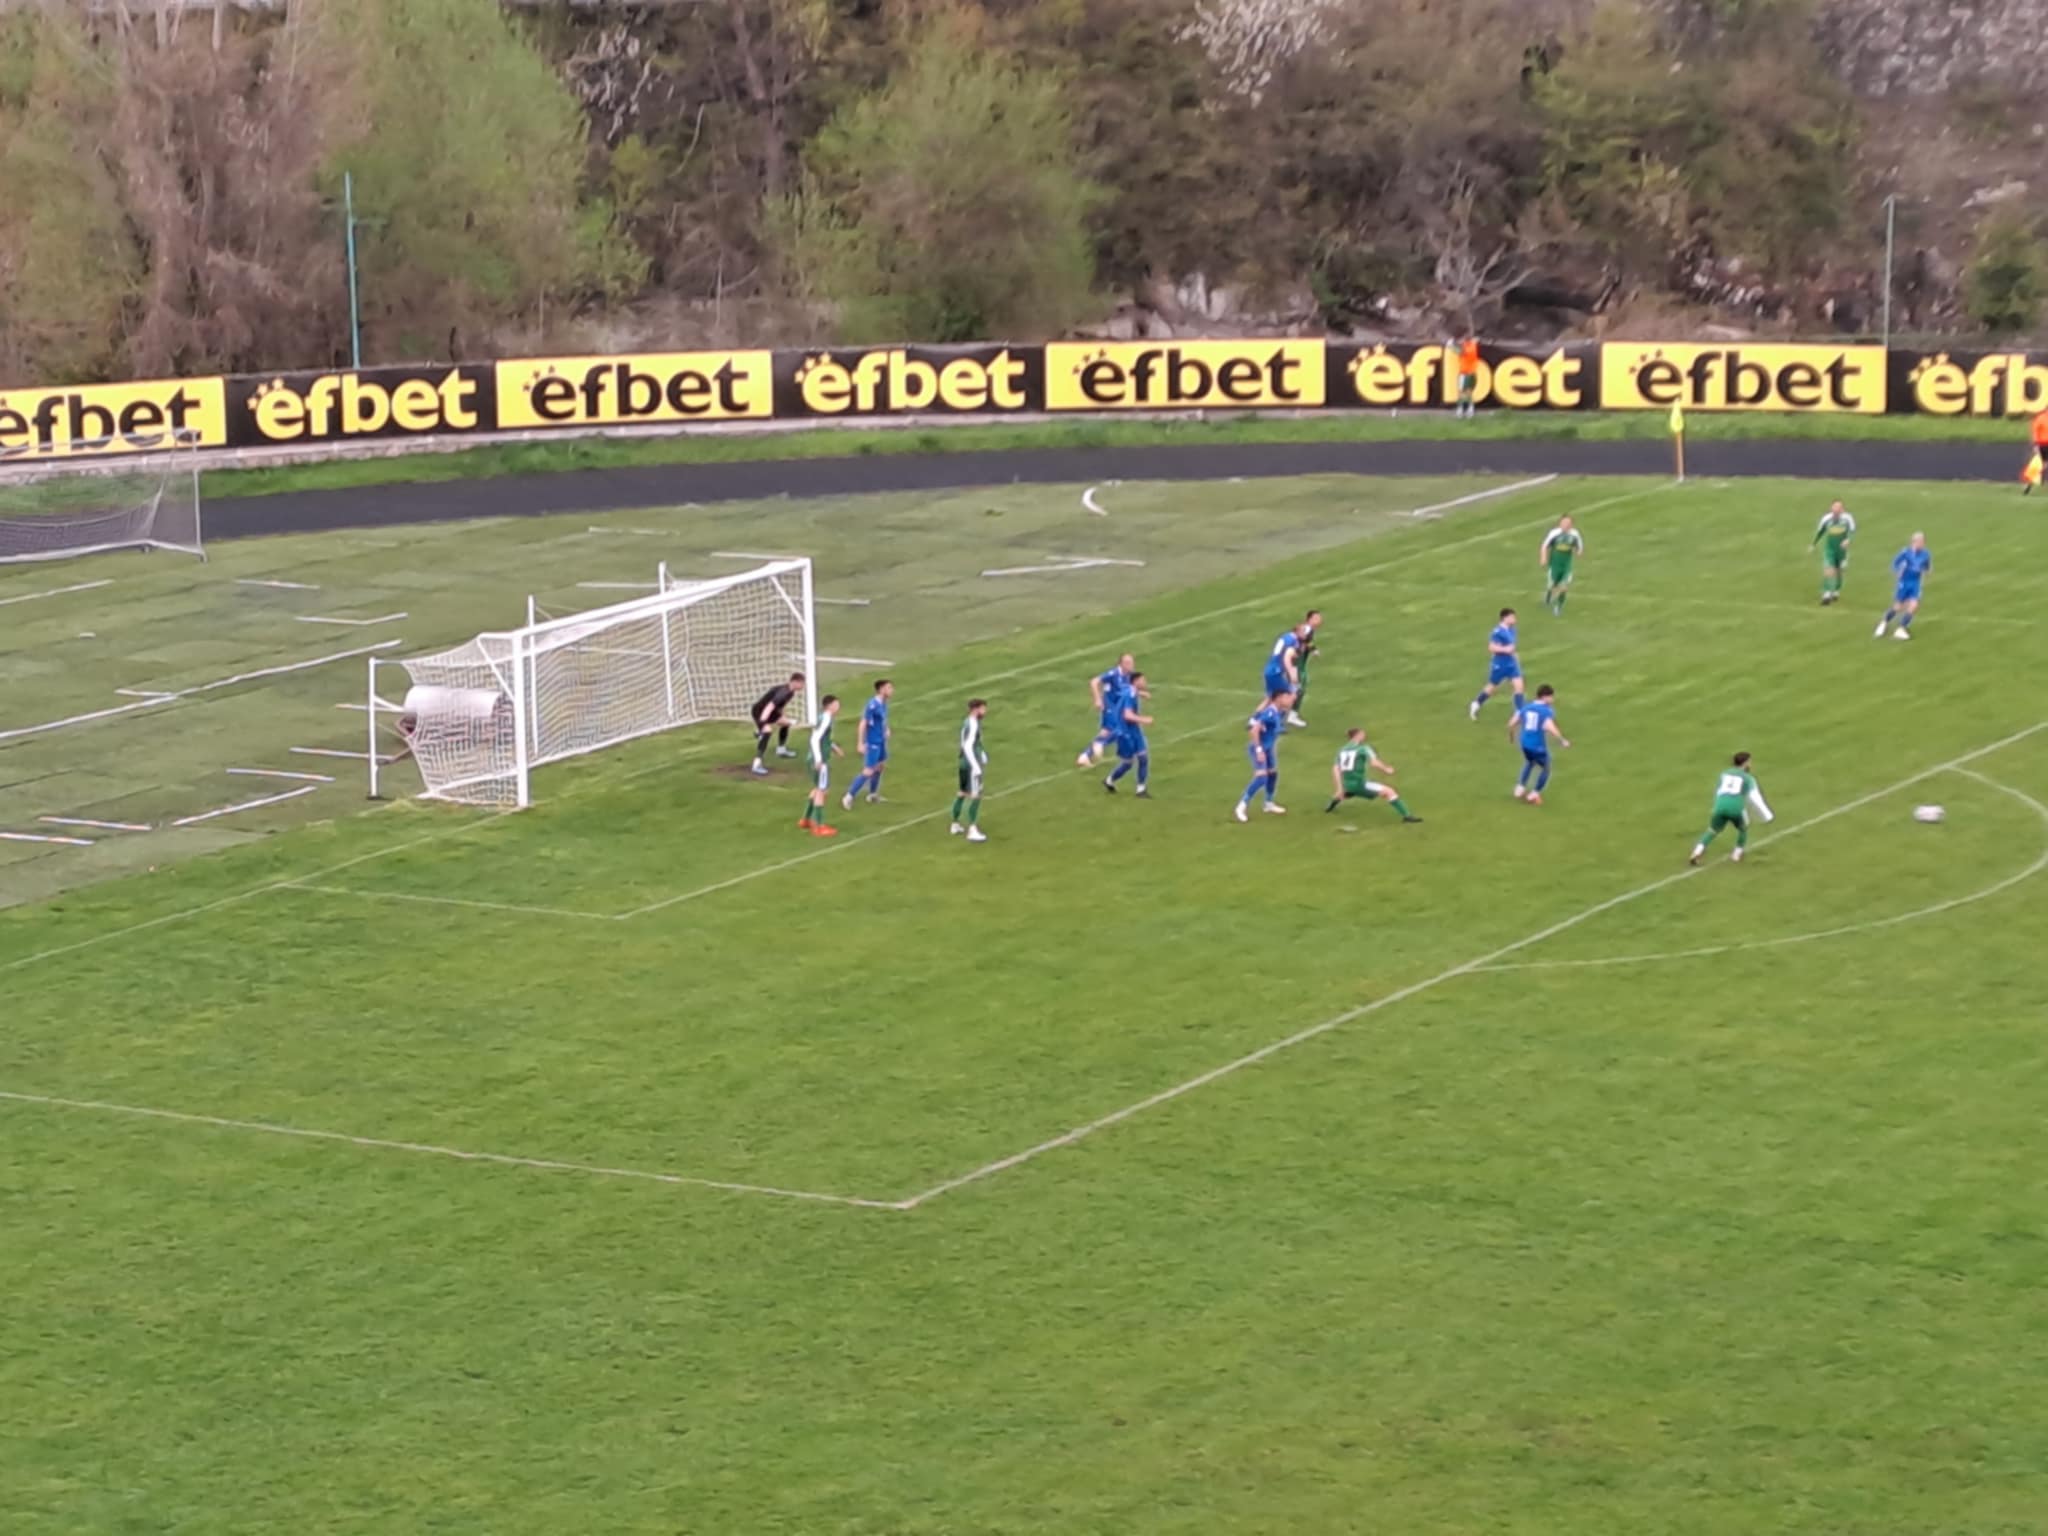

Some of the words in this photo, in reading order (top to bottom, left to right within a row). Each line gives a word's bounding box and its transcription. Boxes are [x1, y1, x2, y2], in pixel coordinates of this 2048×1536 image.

[250, 368, 477, 440] efbet
[526, 357, 749, 420] efbet
[798, 349, 1026, 413] efbet
[1076, 347, 1301, 402] efbet
[1632, 350, 1862, 408] efbet
[0, 387, 202, 453] efbet
